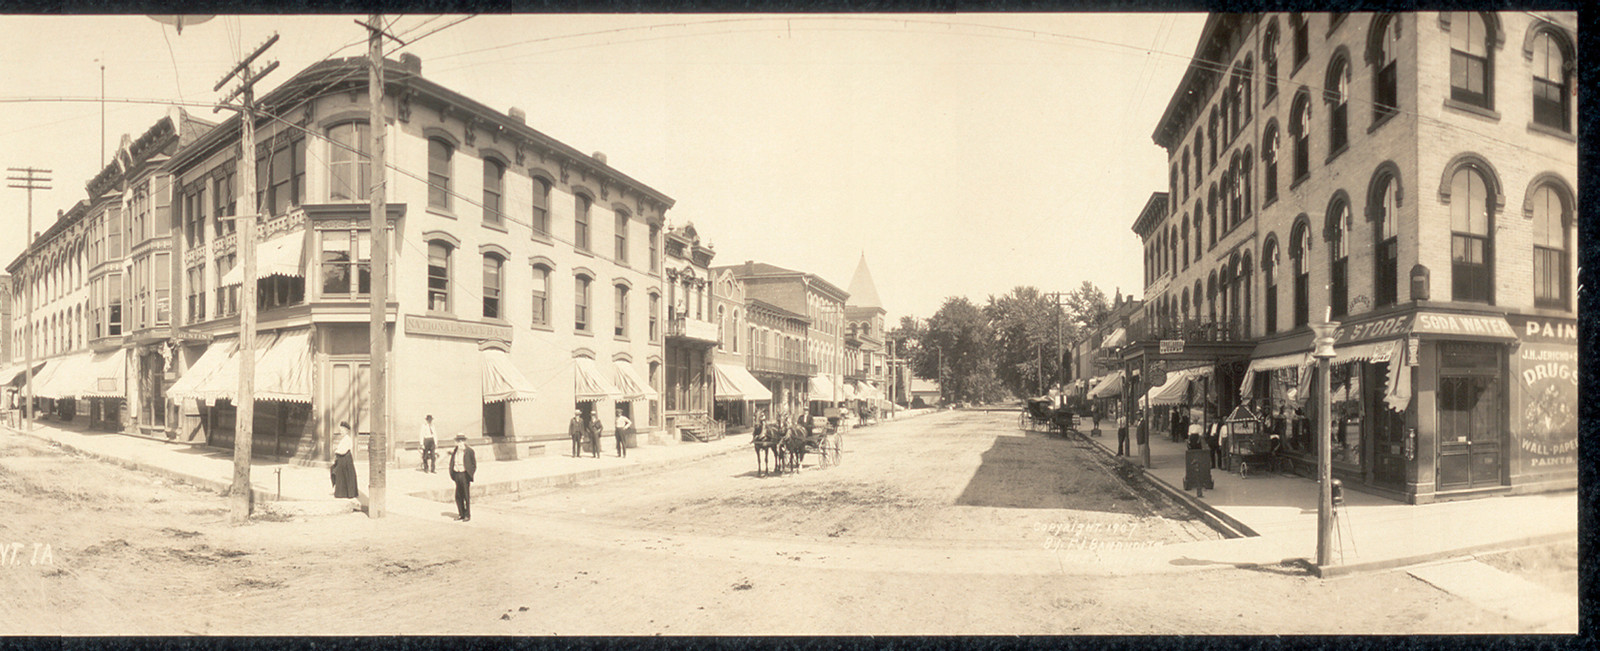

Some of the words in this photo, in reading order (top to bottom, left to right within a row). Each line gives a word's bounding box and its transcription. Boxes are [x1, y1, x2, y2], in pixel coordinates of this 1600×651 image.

[407, 319, 457, 331] NATIONAL
[1420, 315, 1460, 330] SODA
[1460, 317, 1512, 335] WATER
[1523, 362, 1578, 387] DRUGS
